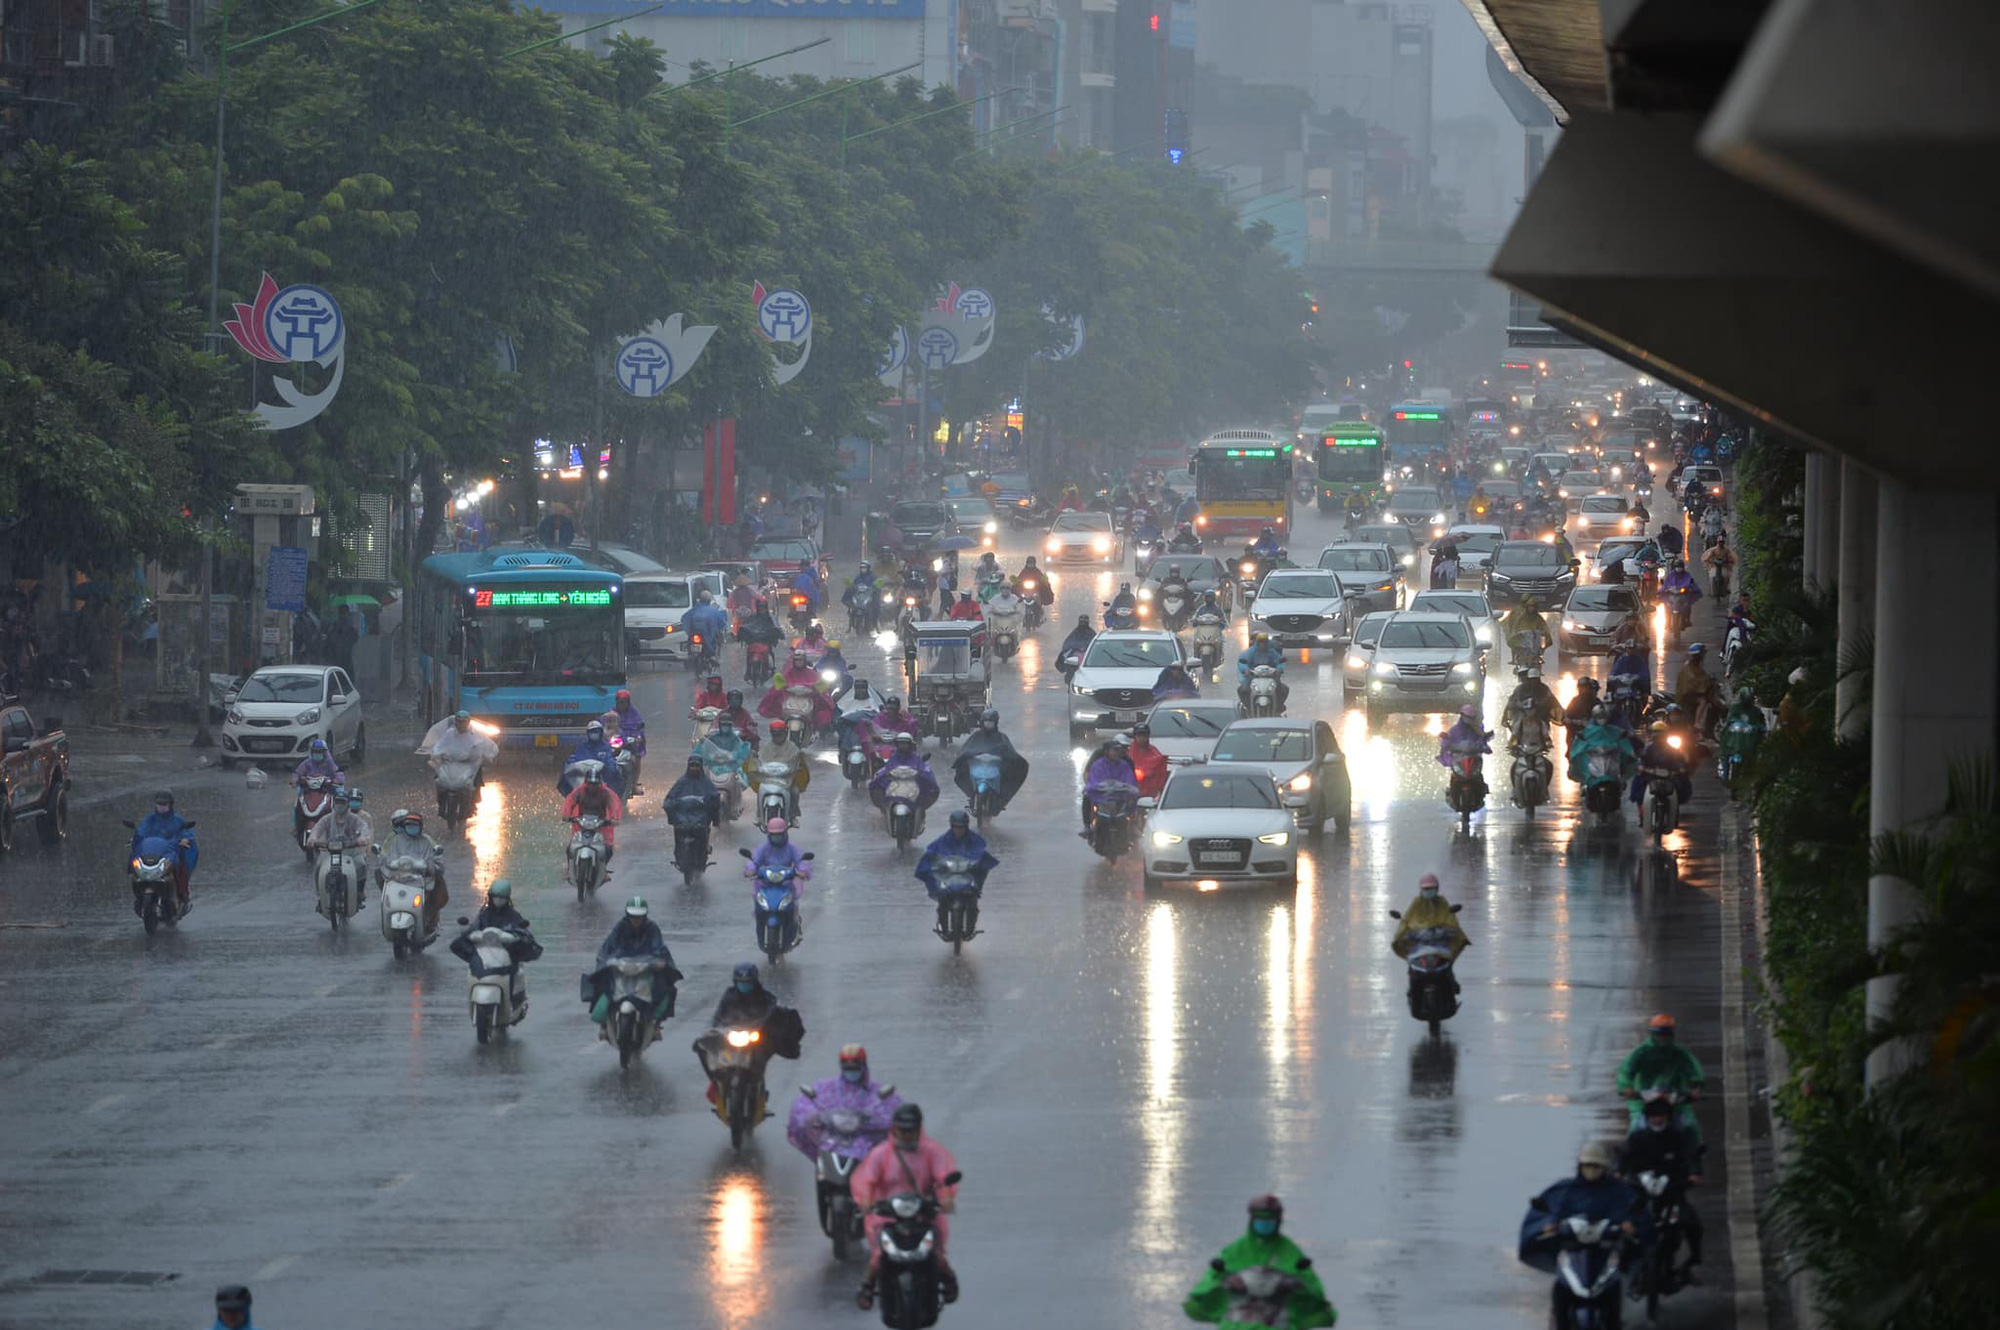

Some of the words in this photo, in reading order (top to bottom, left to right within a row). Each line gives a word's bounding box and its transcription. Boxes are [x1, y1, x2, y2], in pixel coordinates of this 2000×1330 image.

[476, 591, 493, 606] 27
[492, 593, 511, 605] NAM
[538, 593, 560, 605] LONG
[568, 590, 585, 605] YÊN
